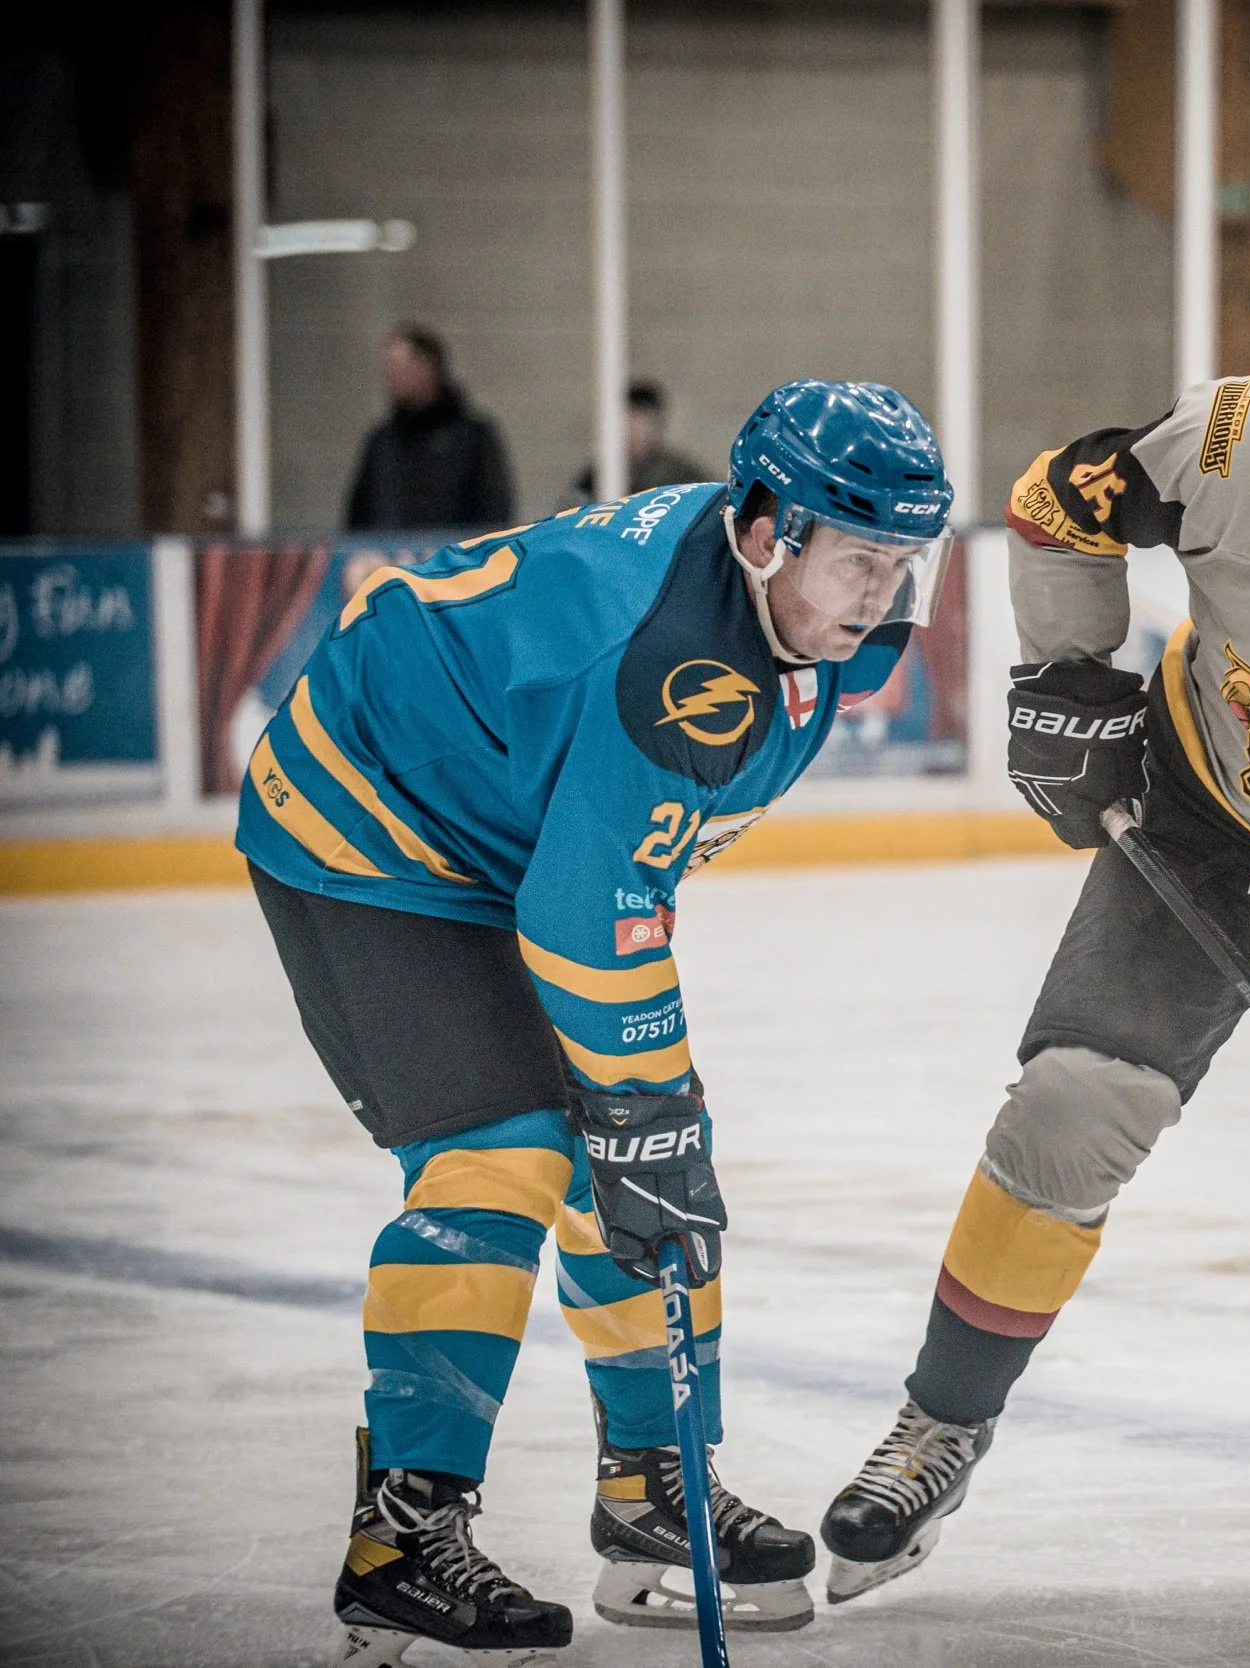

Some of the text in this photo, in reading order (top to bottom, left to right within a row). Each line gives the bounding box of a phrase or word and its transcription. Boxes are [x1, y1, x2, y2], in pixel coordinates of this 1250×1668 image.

[1204, 382, 1248, 470] WARRIORS
[759, 454, 792, 485] CCM
[894, 501, 941, 515] CCM
[1066, 529, 1099, 547] Services
[1010, 706, 1147, 740] BAUER
[633, 801, 701, 870] 21
[621, 1009, 662, 1025] YEADON
[622, 1013, 676, 1043] 07517
[652, 1525, 692, 1551] BAU
[396, 1580, 453, 1614] BAUER
